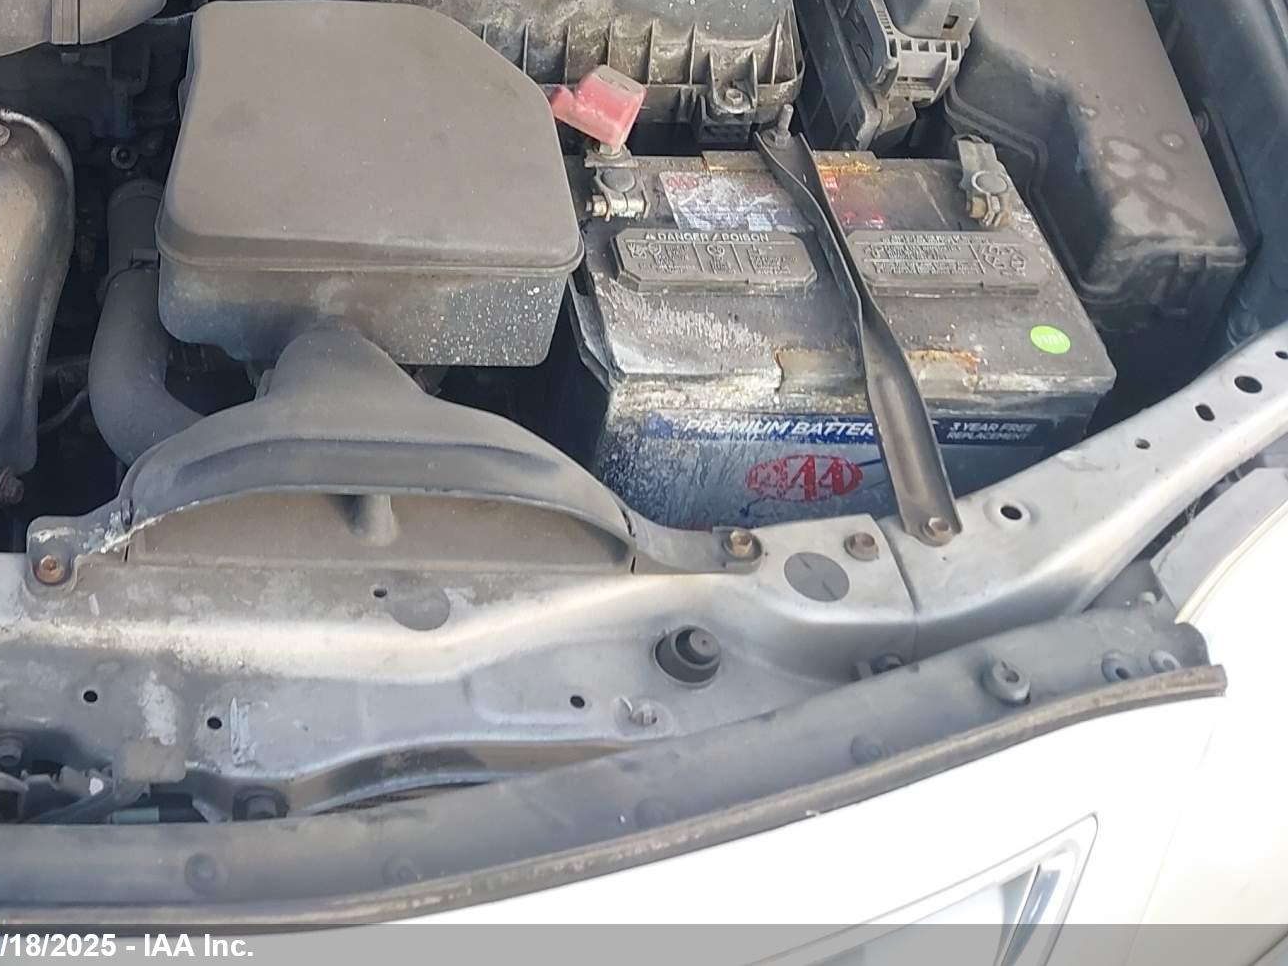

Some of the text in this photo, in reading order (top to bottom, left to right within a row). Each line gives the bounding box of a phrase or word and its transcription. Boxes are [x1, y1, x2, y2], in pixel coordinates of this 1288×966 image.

[657, 232, 710, 243] DANGER
[684, 420, 876, 437] PREMIUM BATTER
[949, 422, 961, 432] 3
[962, 422, 999, 432] YEAR
[999, 423, 1037, 433] FREE
[946, 431, 1030, 441] REPLACEMENT
